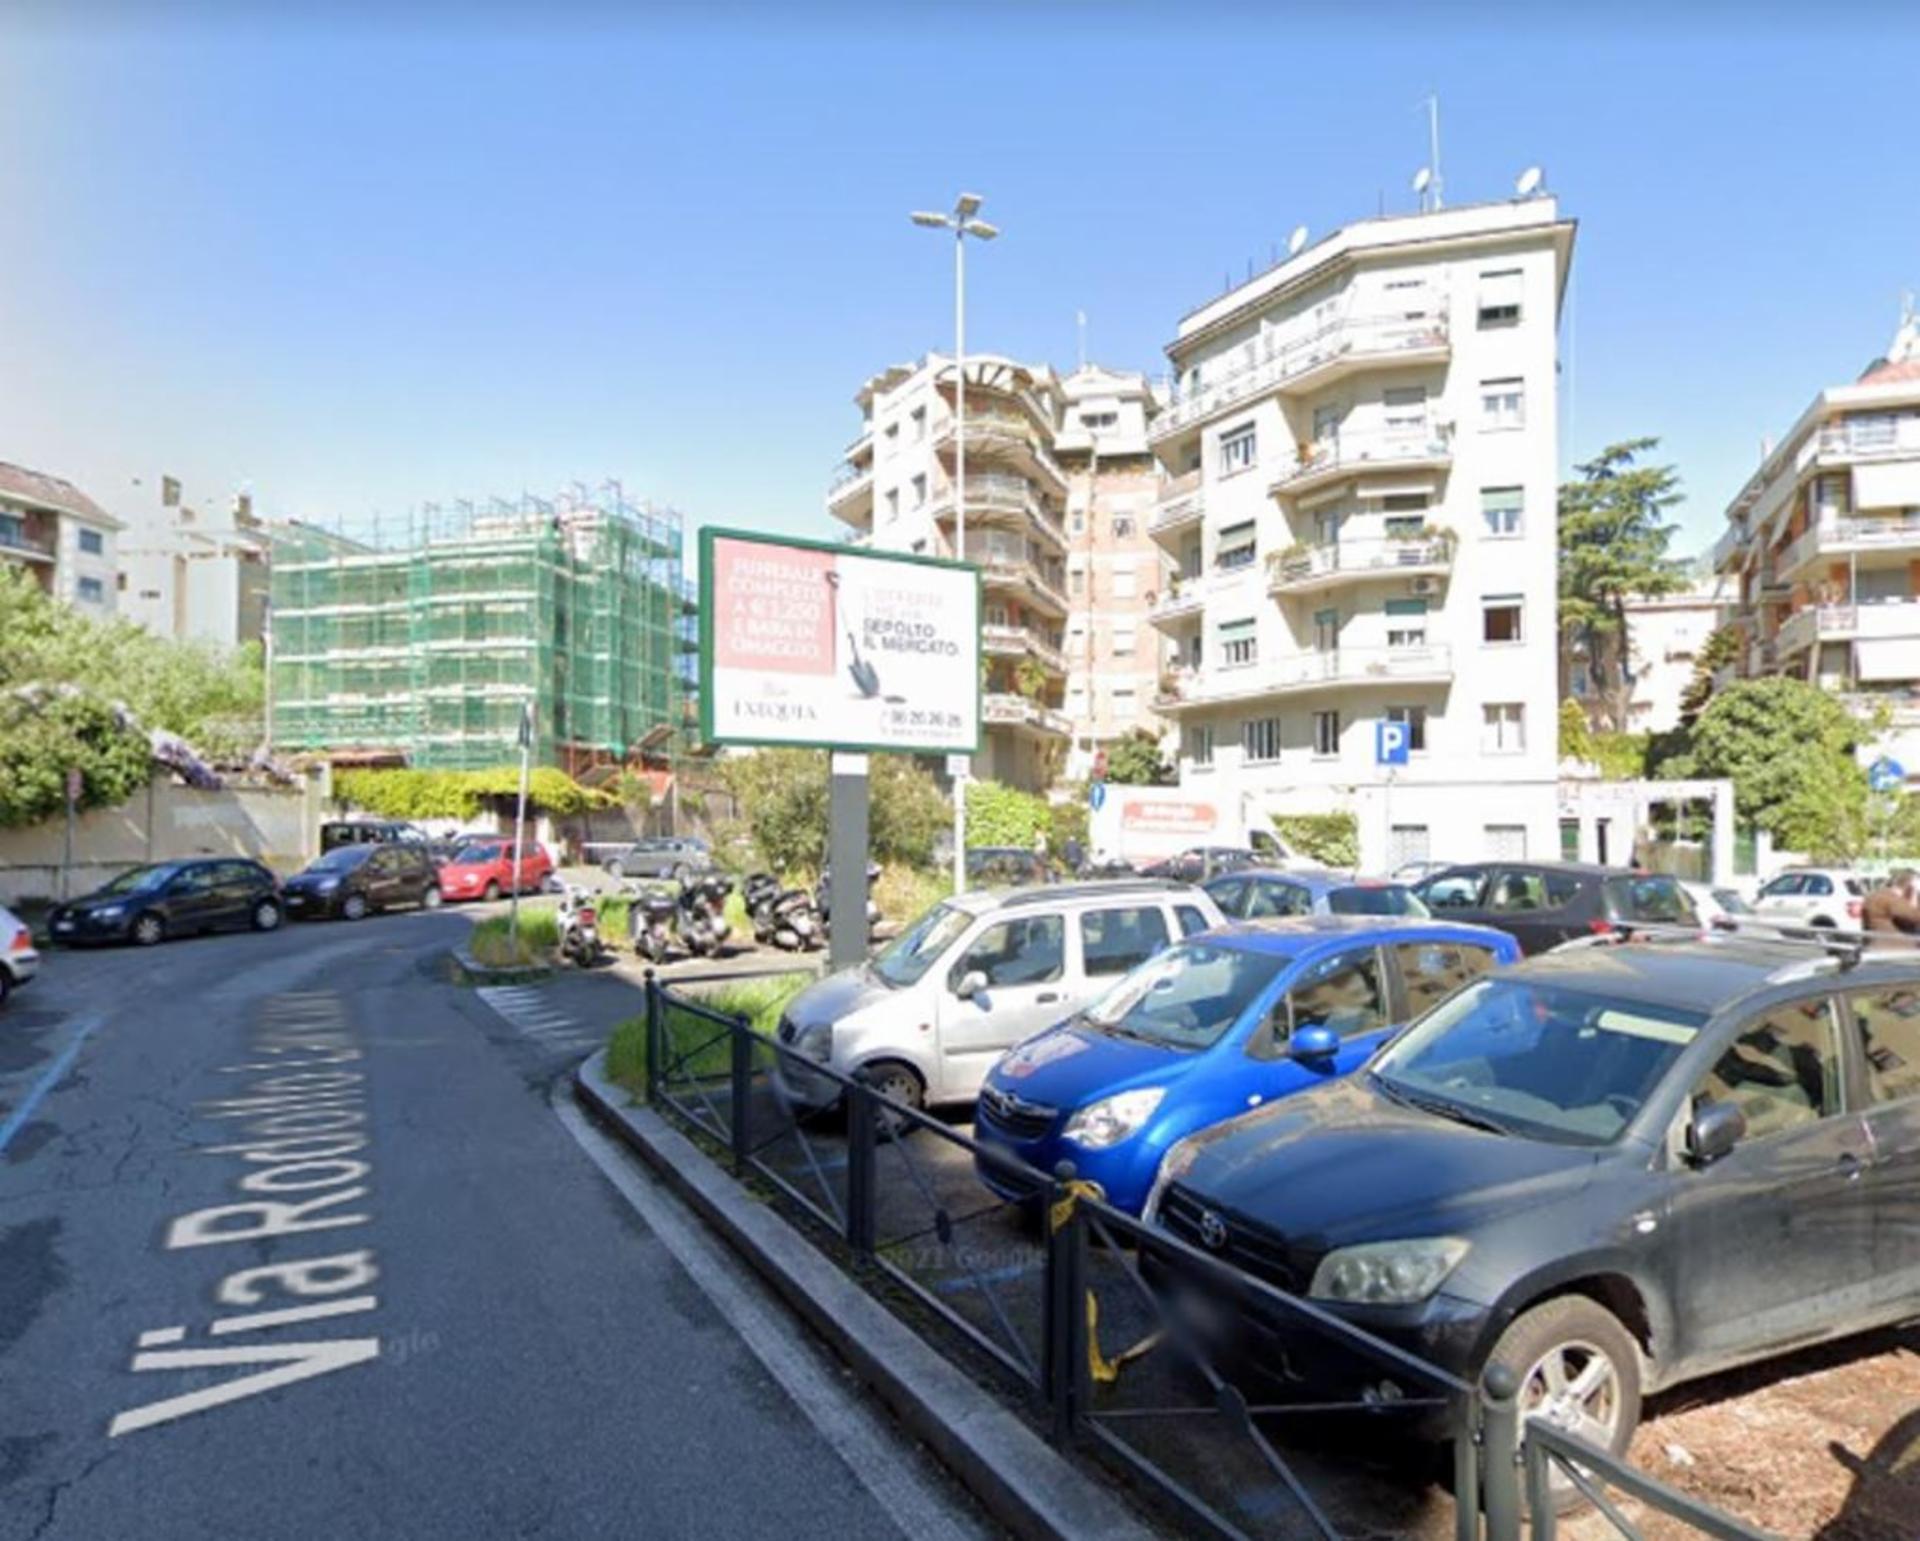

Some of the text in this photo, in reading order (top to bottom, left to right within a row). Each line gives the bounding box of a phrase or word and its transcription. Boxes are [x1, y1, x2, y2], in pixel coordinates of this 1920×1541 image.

[863, 617, 936, 638] SEPOLTO
[863, 634, 960, 657] IL MERCATO
[1382, 726, 1402, 760] P
